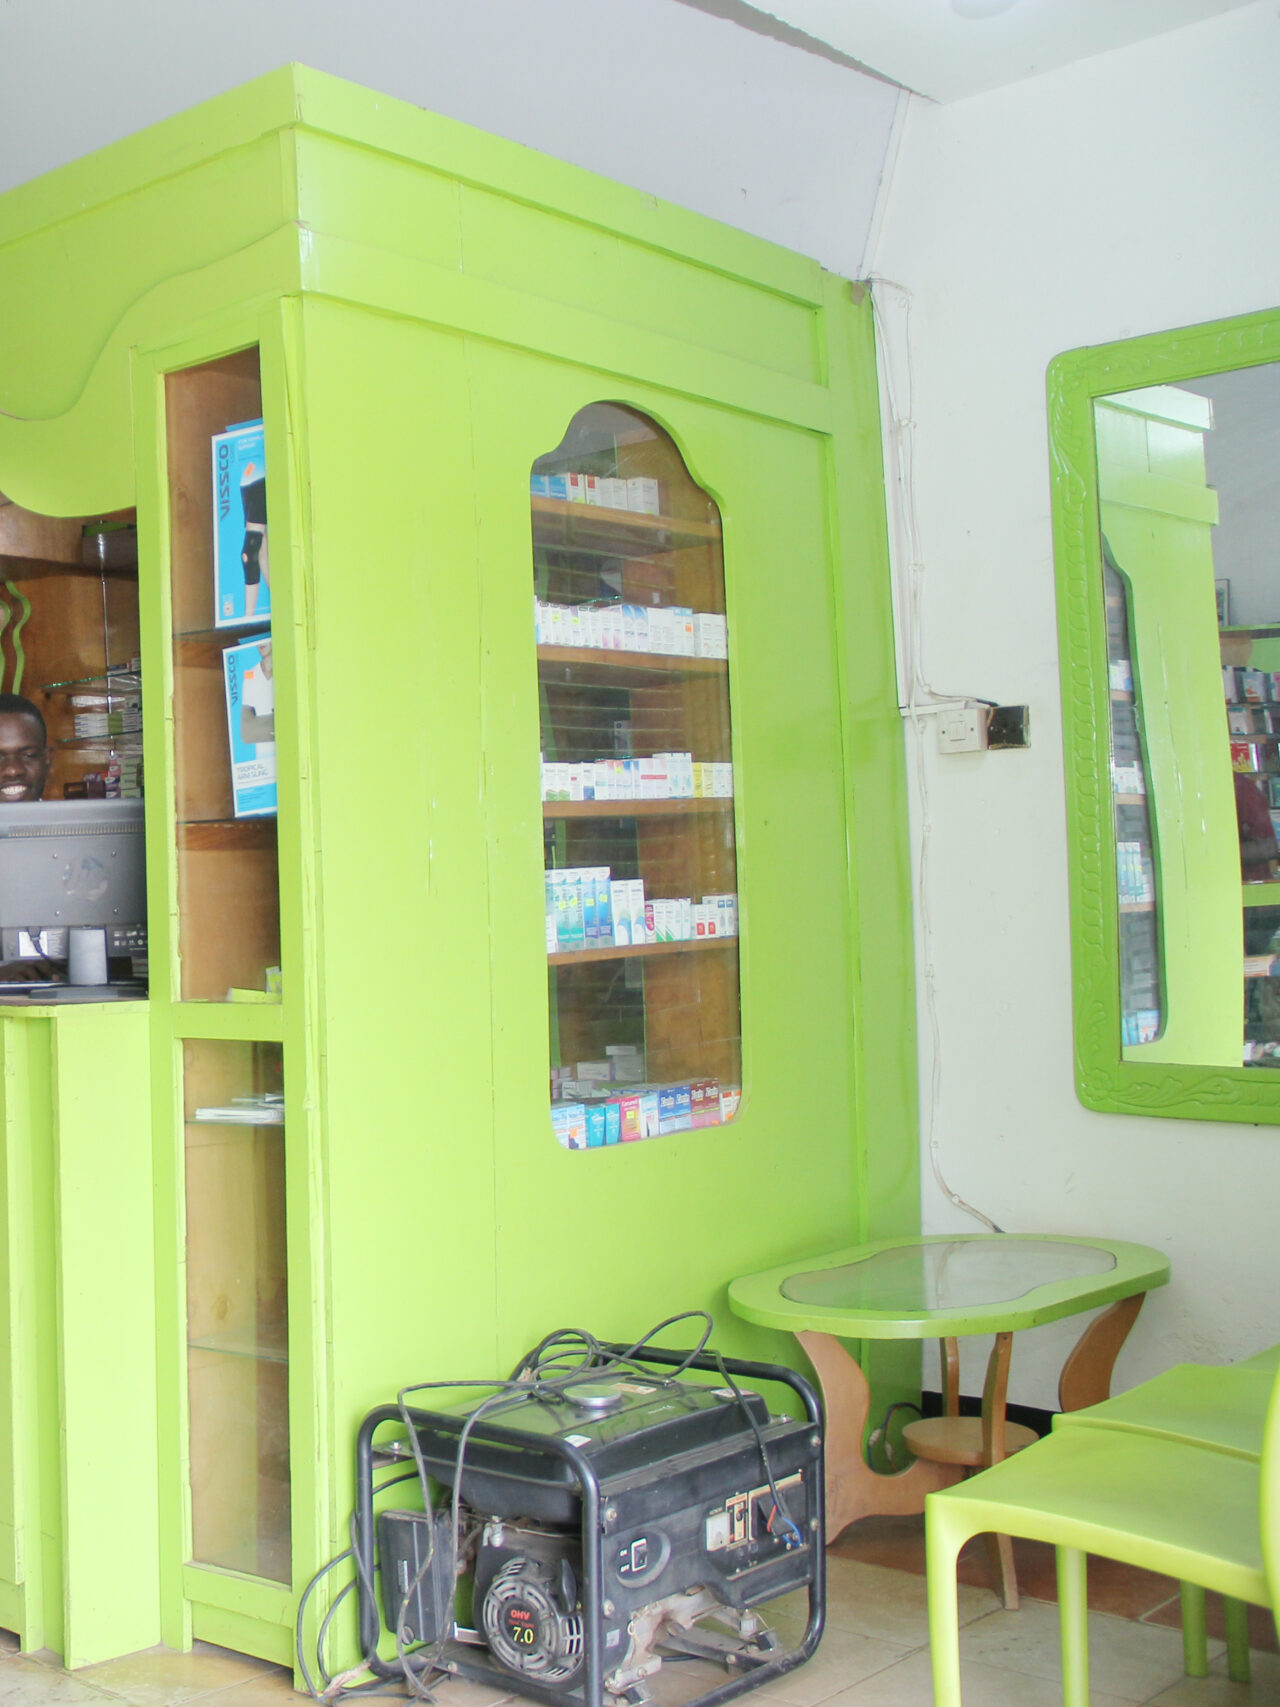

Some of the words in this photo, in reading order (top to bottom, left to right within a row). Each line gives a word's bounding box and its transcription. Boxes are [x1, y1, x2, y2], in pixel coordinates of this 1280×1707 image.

[219, 444, 231, 521] VISSCO
[228, 655, 238, 706] VISSCO
[510, 1609, 531, 1620] OHV
[512, 1626, 535, 1644] 7.0
